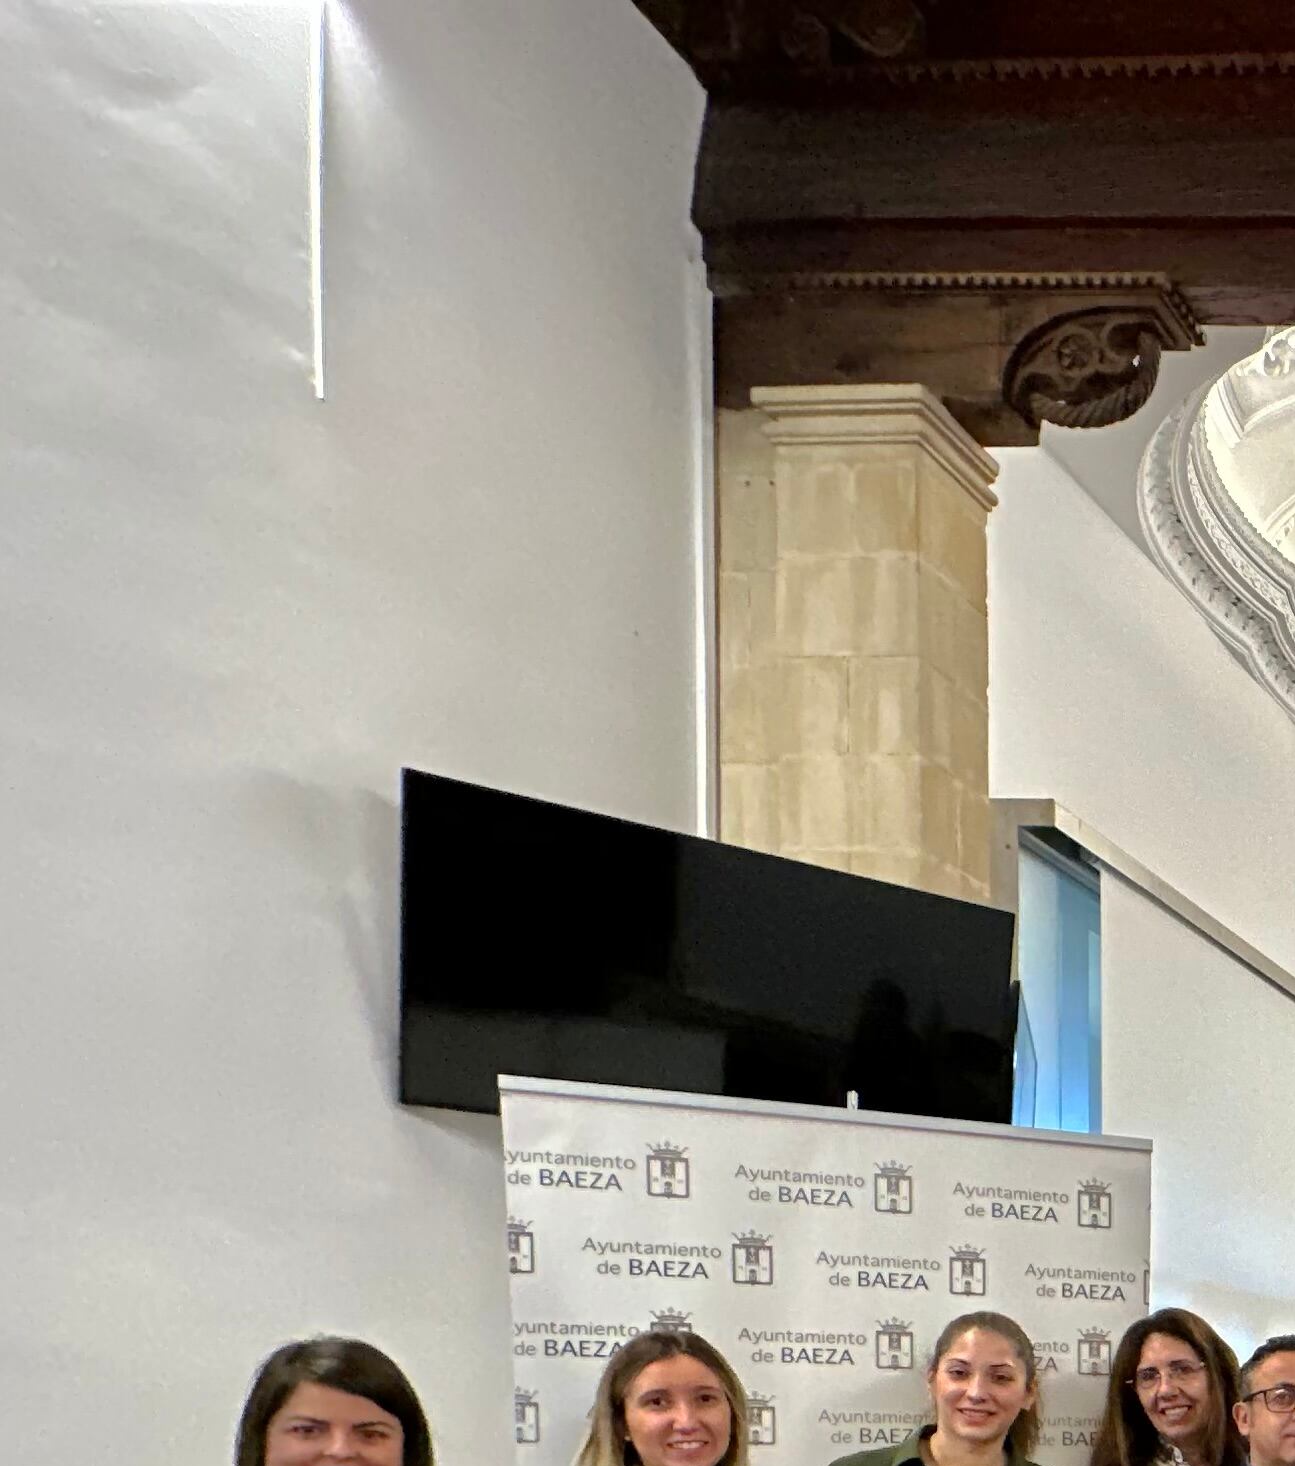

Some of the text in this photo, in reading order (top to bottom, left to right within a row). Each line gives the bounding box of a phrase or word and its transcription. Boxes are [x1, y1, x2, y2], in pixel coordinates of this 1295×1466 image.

[504, 1149, 636, 1170] yuntamiento
[508, 1168, 623, 1192] de BAEZA
[734, 1164, 866, 1189] Ayuntamiento
[748, 1186, 854, 1208] de BAEZA
[952, 1181, 1070, 1205] Ayuntamiento
[964, 1202, 1059, 1223] de BAEZA
[581, 1237, 723, 1260] Ayuntamiento
[596, 1258, 710, 1280] de BAEZA
[816, 1250, 942, 1272] Ayuntamiento
[828, 1271, 929, 1291] de BAEZA
[1024, 1263, 1137, 1284] Ayuntamiento
[1035, 1282, 1127, 1302] de BAEZA
[514, 1321, 640, 1339] yuntamiento
[738, 1327, 867, 1346] Ayuntamiento
[514, 1341, 537, 1357] de
[751, 1346, 855, 1366] de BAEZA
[830, 1430, 851, 1444] de
